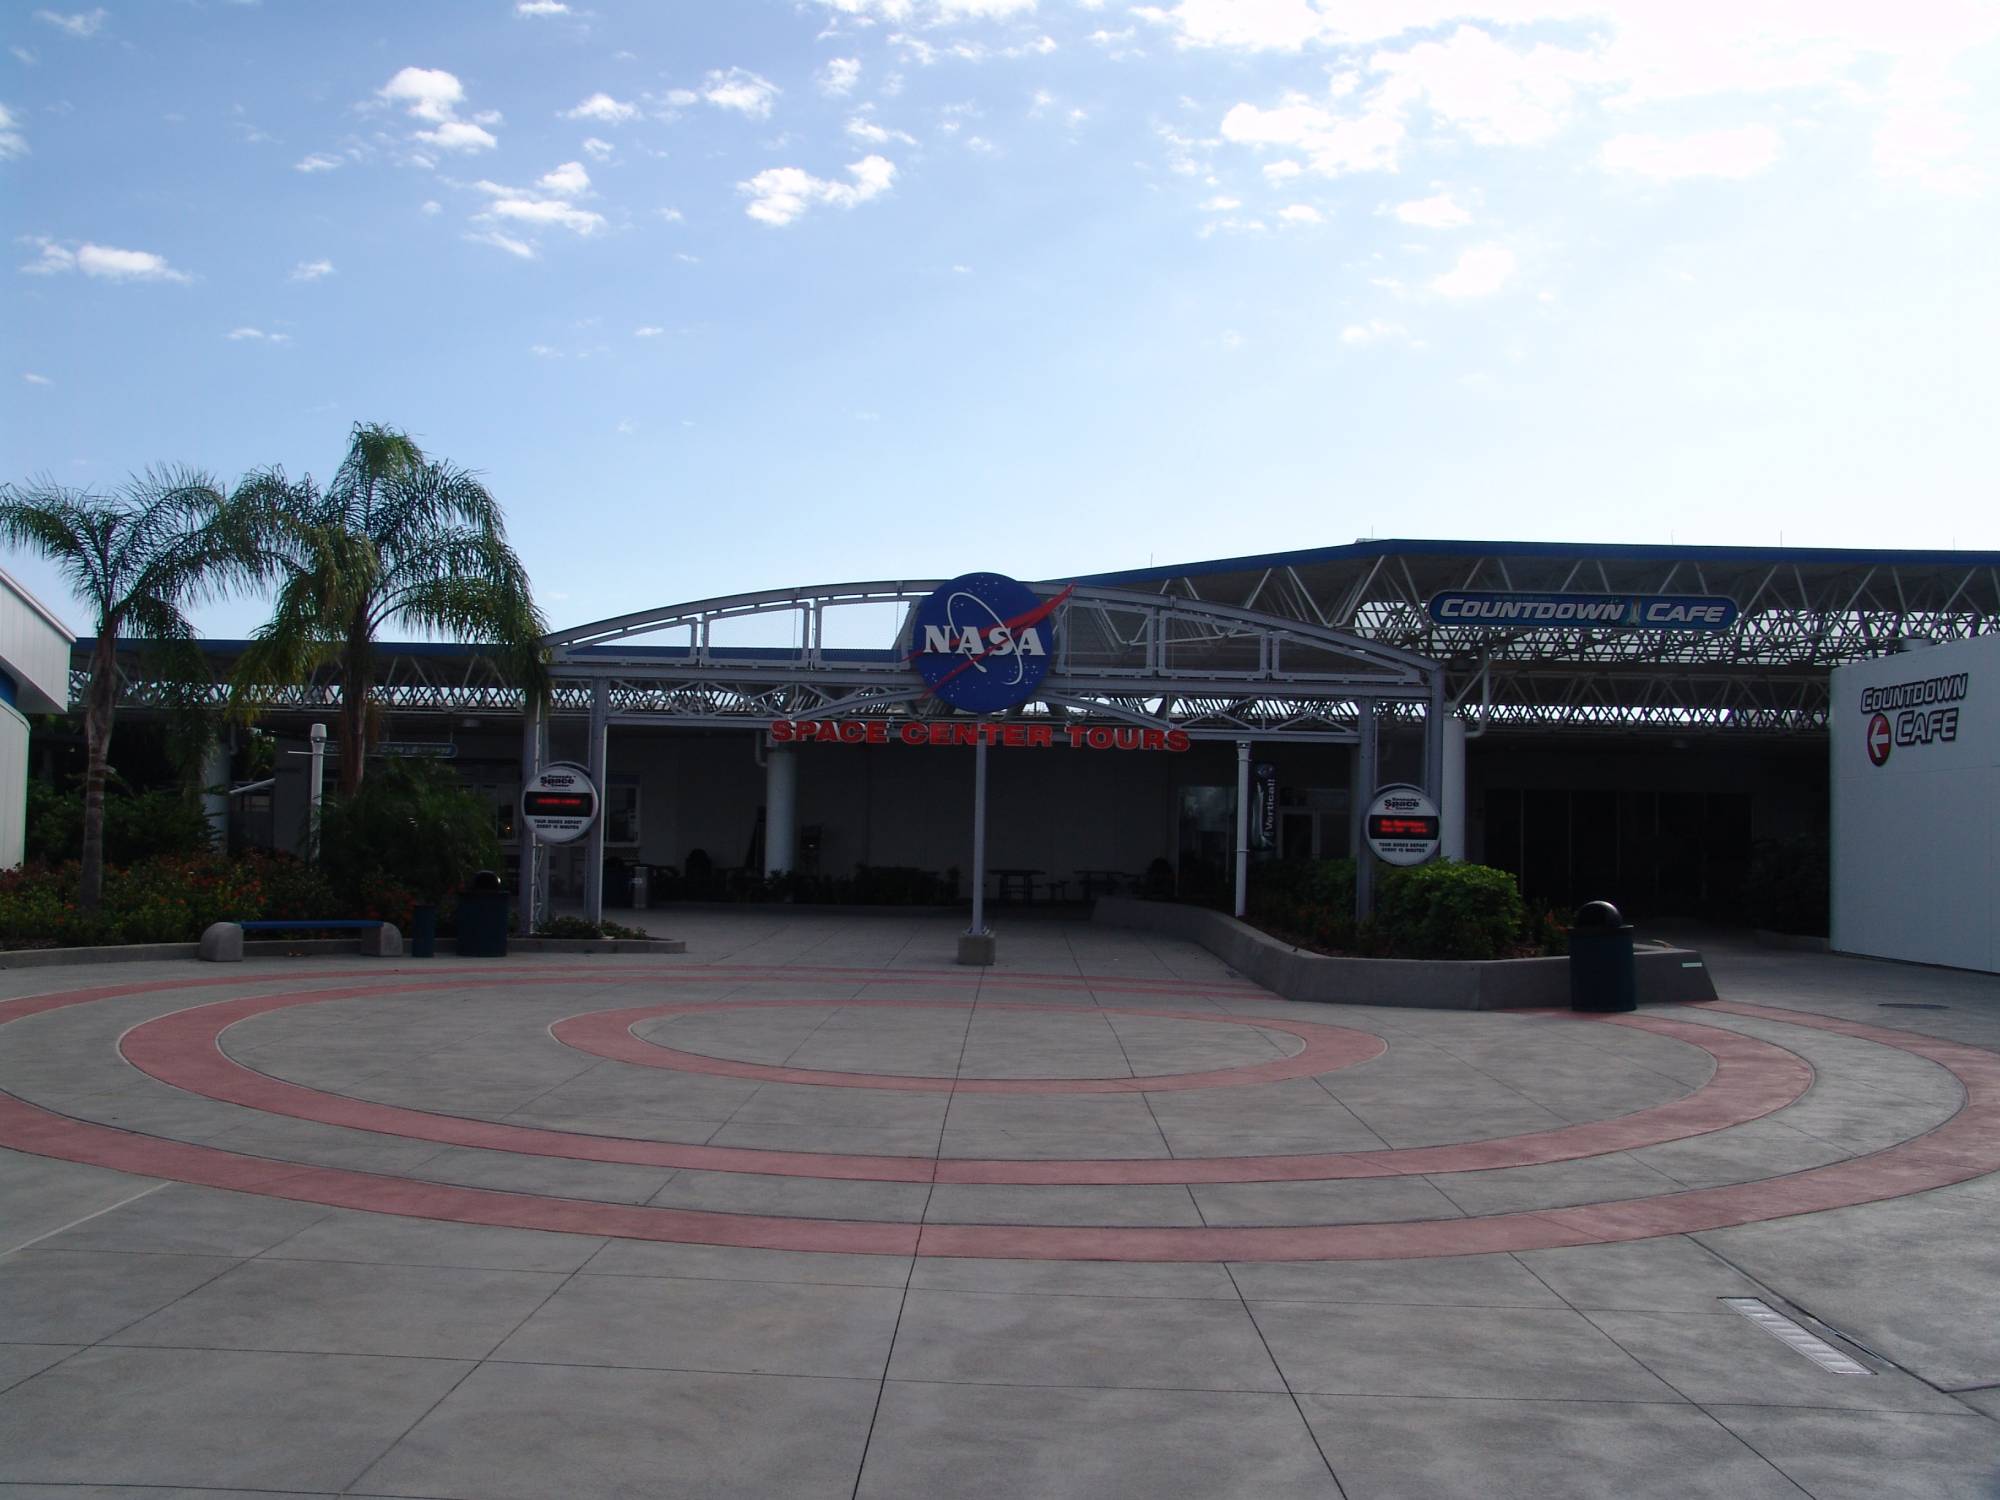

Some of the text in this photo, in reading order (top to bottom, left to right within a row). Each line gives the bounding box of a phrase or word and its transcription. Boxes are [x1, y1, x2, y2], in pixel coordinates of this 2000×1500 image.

[1440, 599, 1726, 623] COUNTDOWN CAFE
[923, 625, 1046, 657] NASA
[1860, 672, 1969, 714] COUNTDOWN
[770, 719, 1190, 752] SPACE CENTER TOURS
[1895, 707, 1960, 747] CAFE
[540, 776, 575, 785] Space
[1384, 799, 1419, 808] Space
